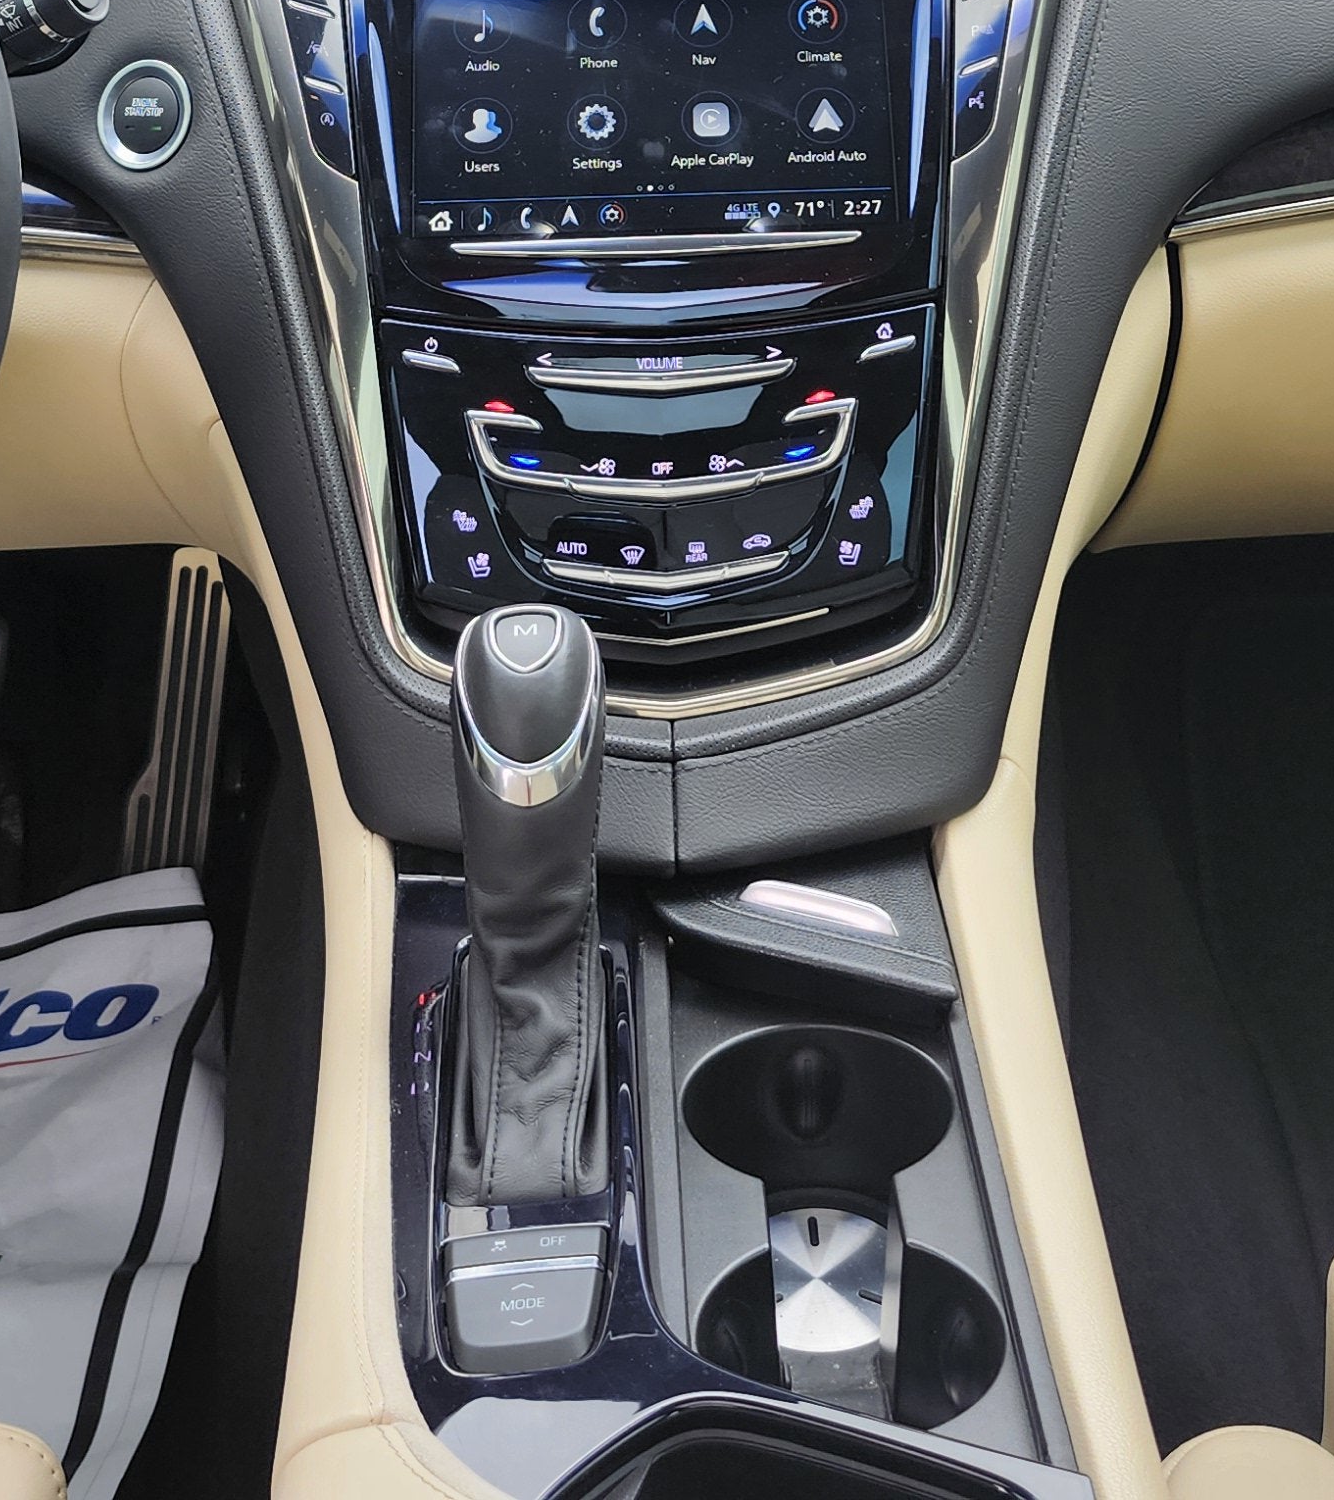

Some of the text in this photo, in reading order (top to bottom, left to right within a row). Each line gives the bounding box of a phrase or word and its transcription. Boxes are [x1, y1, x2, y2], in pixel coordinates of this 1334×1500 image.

[6, 16, 24, 33] INT
[579, 56, 619, 70] Phone
[692, 54, 717, 65] Nav
[797, 51, 843, 63] Climate
[465, 60, 500, 73] Audio
[131, 97, 159, 107] ENGINE
[124, 106, 164, 117] START/STOP
[671, 153, 754, 168] Apple CarPlay
[788, 150, 867, 163] Android Auto
[465, 161, 501, 173] Users
[572, 157, 623, 171] Settings
[726, 203, 759, 212] 4G LTE
[794, 200, 825, 217] 71°
[843, 199, 882, 216] 2:27
[636, 356, 684, 370] VOLUME
[652, 461, 674, 476] OFF
[556, 541, 588, 555] AUTO
[685, 552, 708, 564] REAR
[513, 622, 538, 637] M
[539, 1235, 566, 1247] OFF
[500, 1296, 545, 1312] MODE
